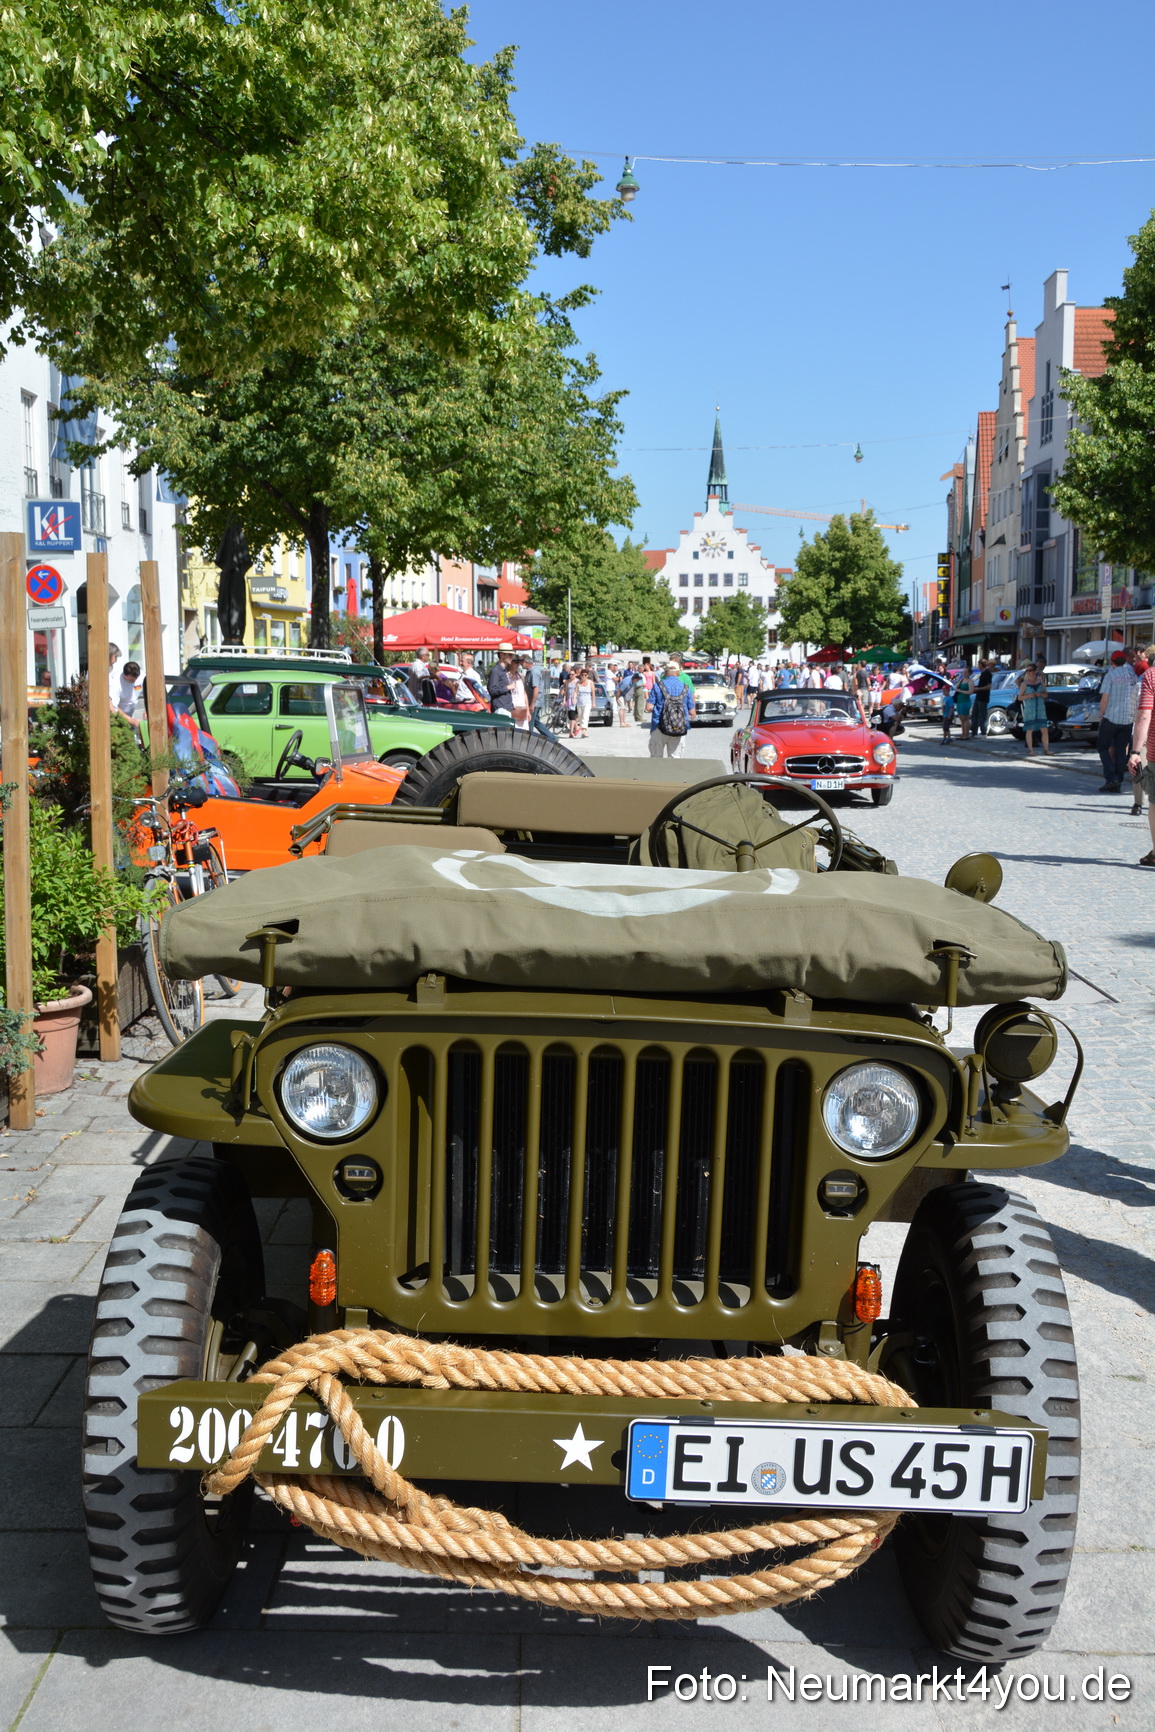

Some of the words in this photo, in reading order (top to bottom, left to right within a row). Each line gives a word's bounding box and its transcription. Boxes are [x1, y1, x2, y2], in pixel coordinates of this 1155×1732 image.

[34, 506, 74, 541] K&L
[938, 554, 950, 617] HOTEL
[816, 780, 822, 788] N
[642, 1469, 655, 1485] D
[673, 1434, 748, 1493] EI
[793, 1438, 875, 1496] US
